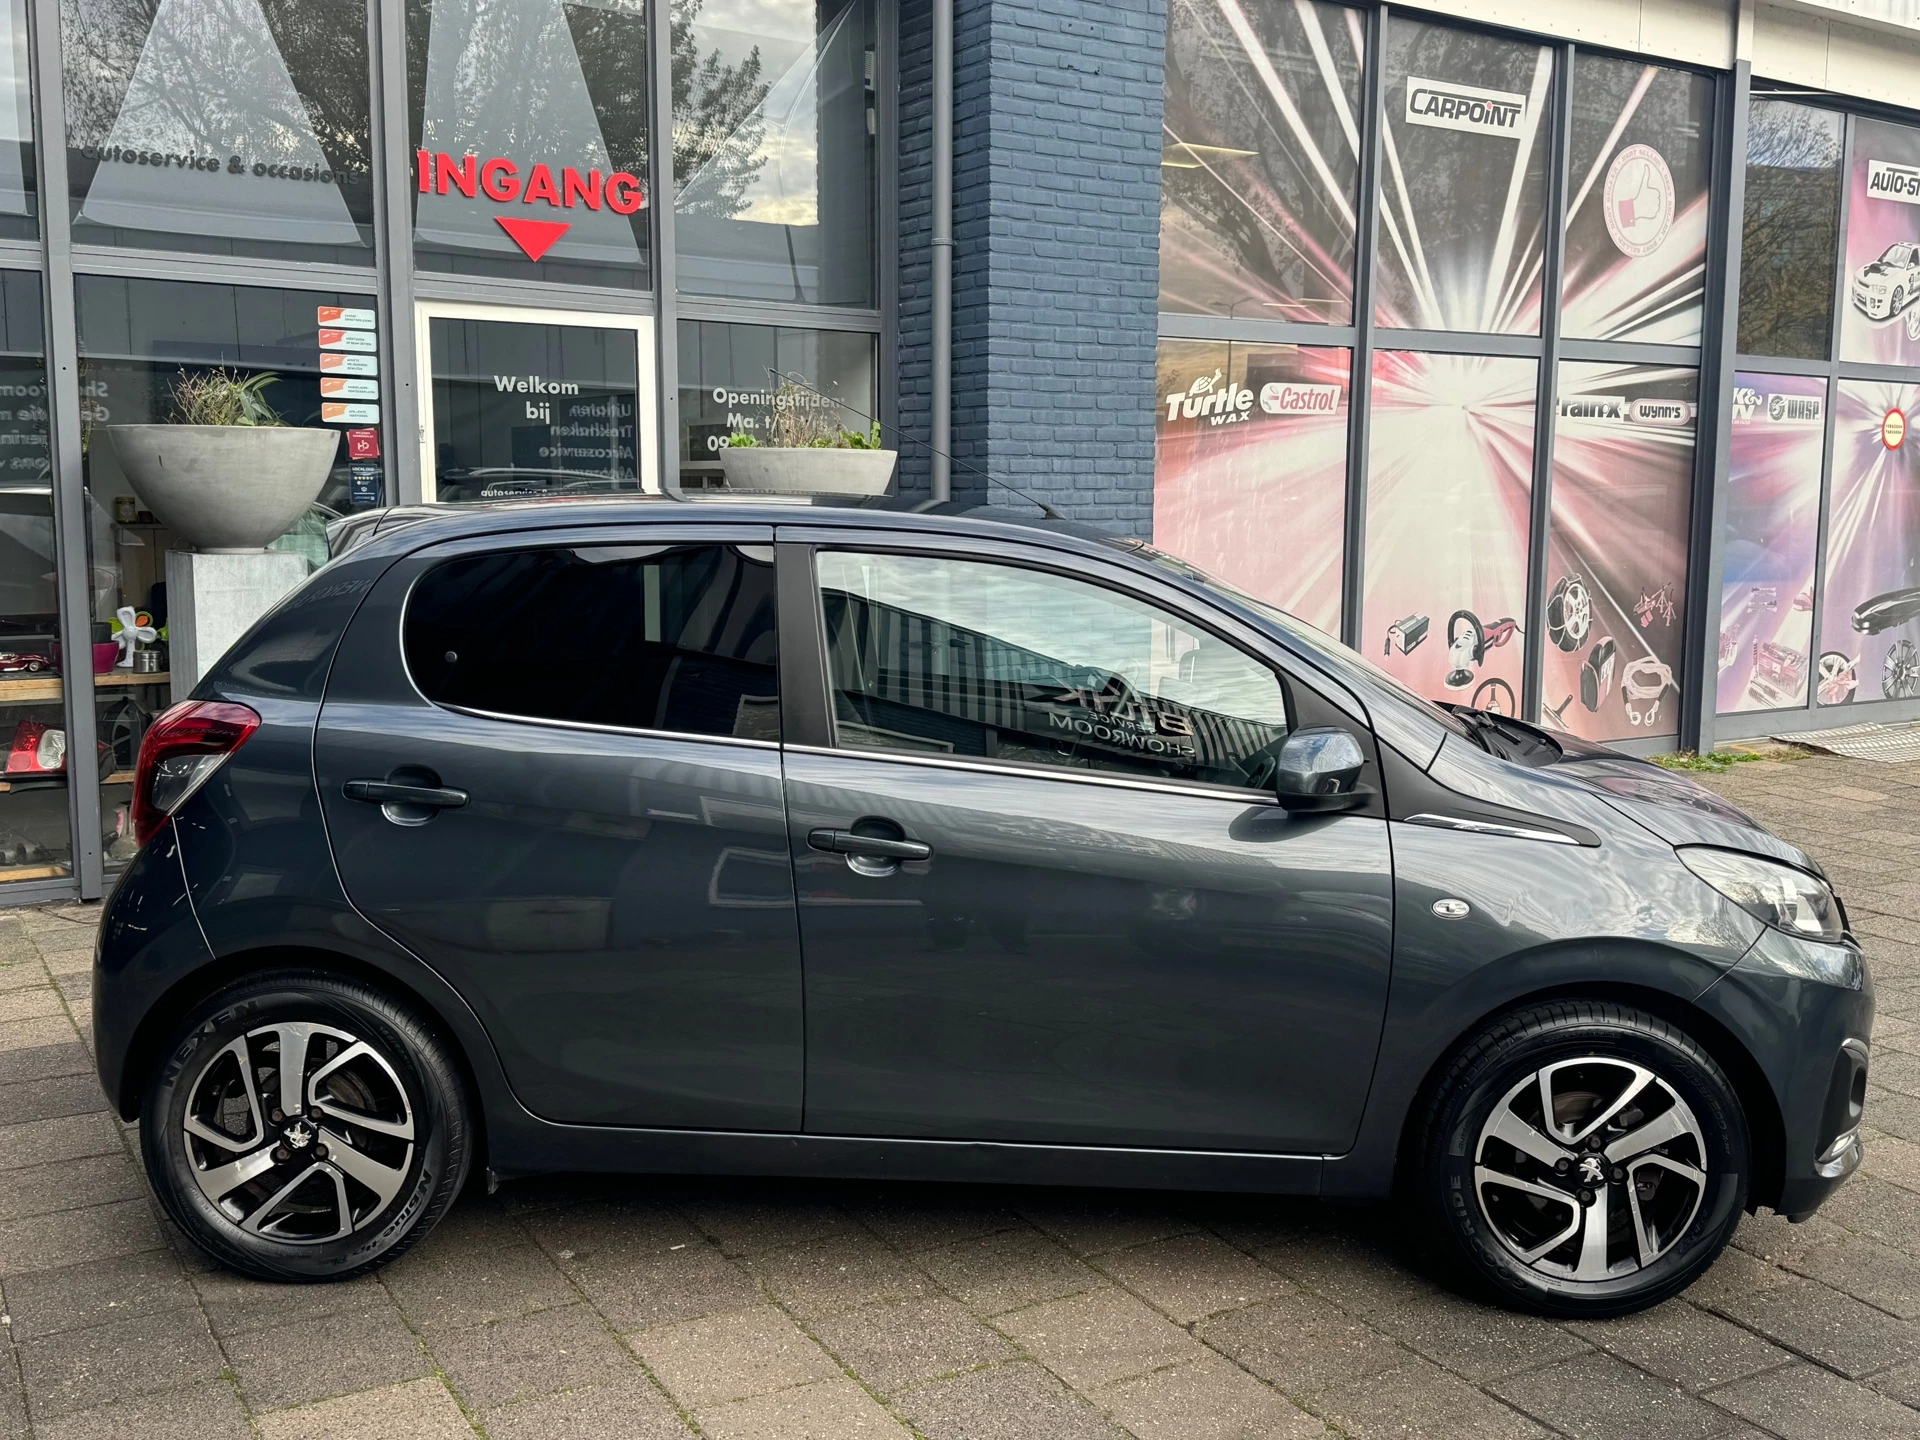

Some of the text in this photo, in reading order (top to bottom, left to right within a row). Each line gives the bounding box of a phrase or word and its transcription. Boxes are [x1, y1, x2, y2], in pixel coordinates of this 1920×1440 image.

[82, 146, 358, 186] autoservice & occasions
[417, 149, 643, 215] INGANG
[494, 375, 579, 395] Welkom
[1166, 383, 1254, 422] Turtle
[1279, 386, 1336, 411] Castrol
[1787, 399, 1820, 421] WASP
[526, 401, 550, 424] bij
[1210, 411, 1251, 426] WAX
[160, 1000, 257, 1090] NEXEN
